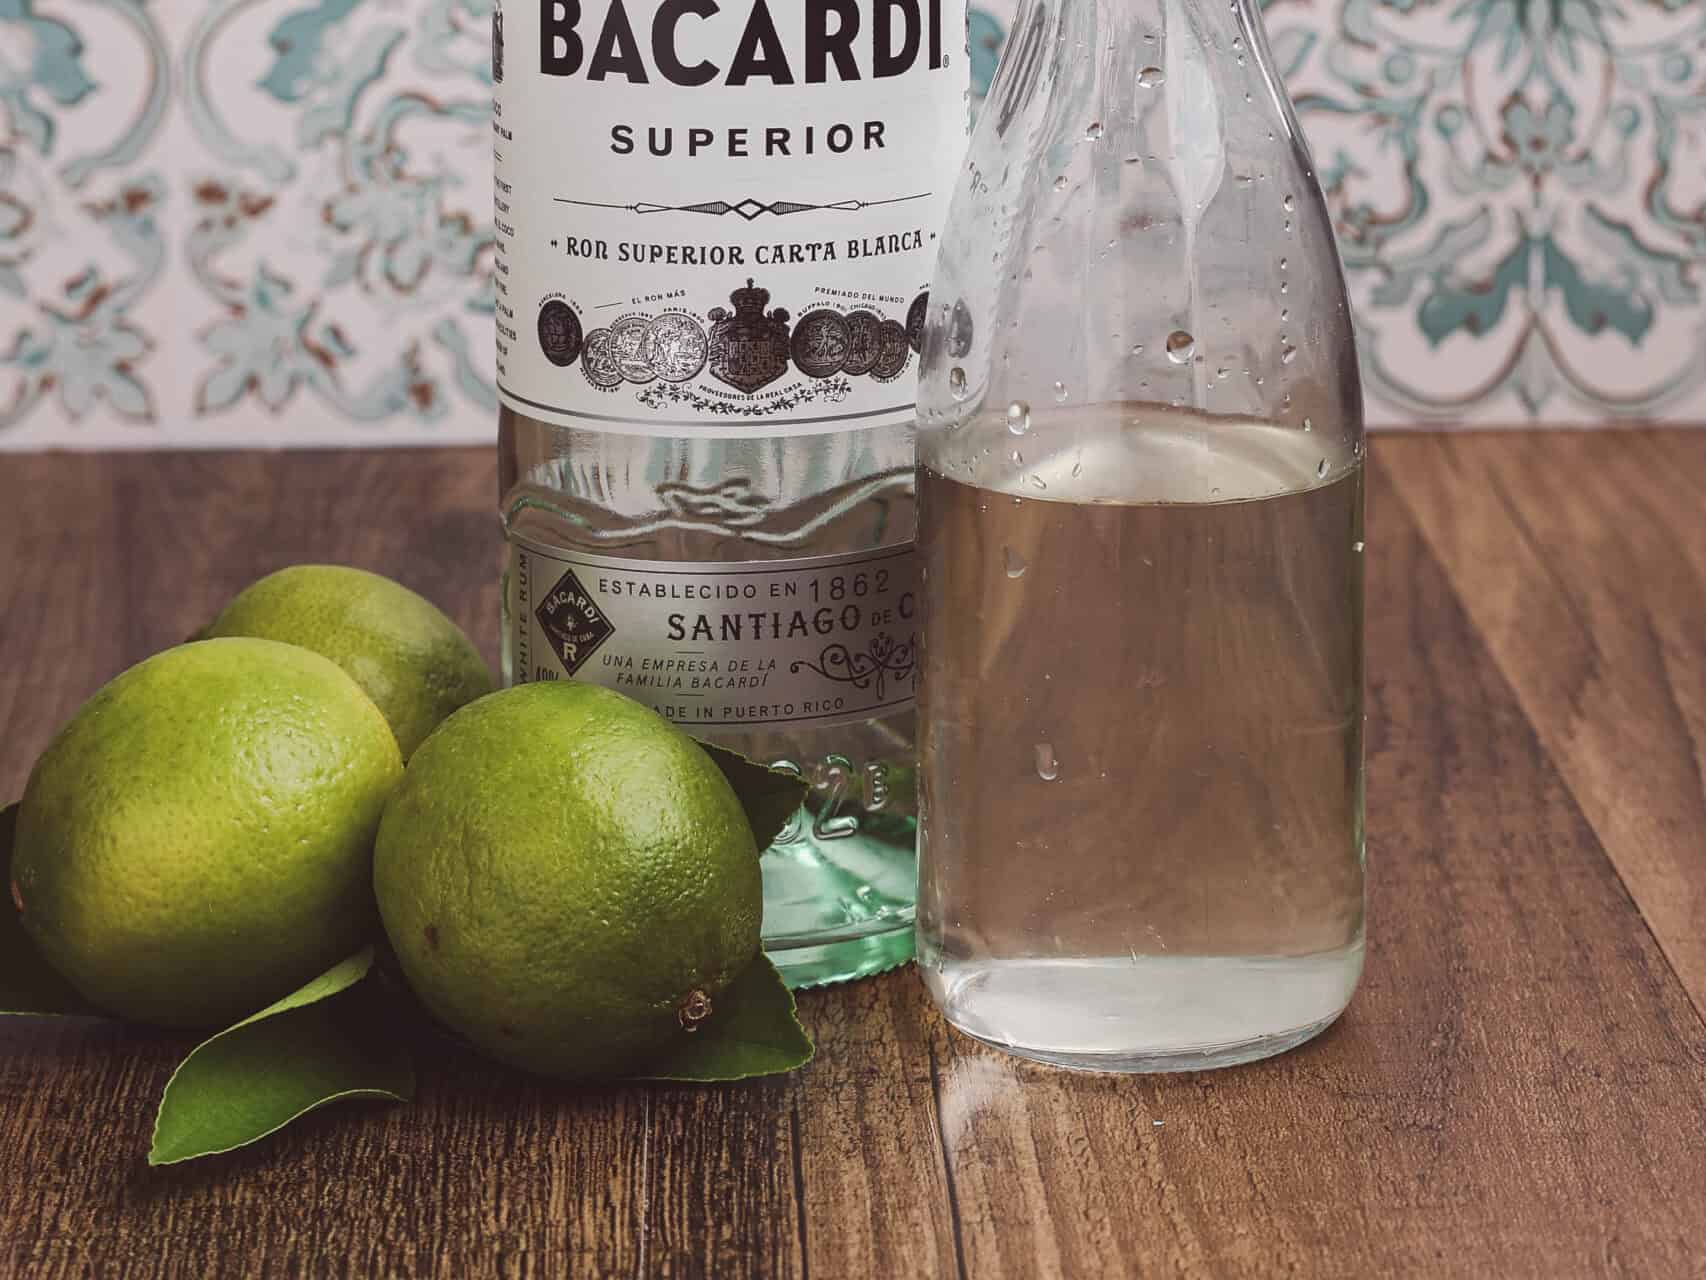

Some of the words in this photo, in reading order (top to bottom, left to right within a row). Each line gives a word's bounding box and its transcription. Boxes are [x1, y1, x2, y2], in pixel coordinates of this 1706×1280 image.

[610, 120, 886, 157] SUPERIOR
[566, 236, 609, 260] RON
[618, 242, 745, 265] SUPERIOR
[755, 241, 837, 265] CARTA
[848, 230, 923, 259] BLANCA
[632, 297, 642, 305] EL
[645, 294, 663, 303] RON
[666, 289, 686, 301] MÁS
[815, 286, 860, 299] PREMIADO
[862, 291, 876, 301] DEL
[879, 293, 905, 304] MUNDO
[600, 579, 756, 600] ESTABLECIDO
[770, 582, 796, 597] EN
[809, 570, 889, 603] 1862
[667, 605, 861, 641] SANTIAGO
[871, 609, 892, 627] DE
[563, 643, 578, 662] R
[602, 655, 633, 669] UNA
[642, 658, 719, 672] EMPRESA
[728, 659, 751, 672] DE
[754, 658, 776, 671] LA
[616, 672, 682, 688] FAMILIA
[691, 673, 769, 689] BACARDÍ
[652, 704, 687, 718] ADE
[696, 705, 713, 718] IN
[724, 703, 794, 718] PUERTO
[803, 697, 845, 713] RICO
